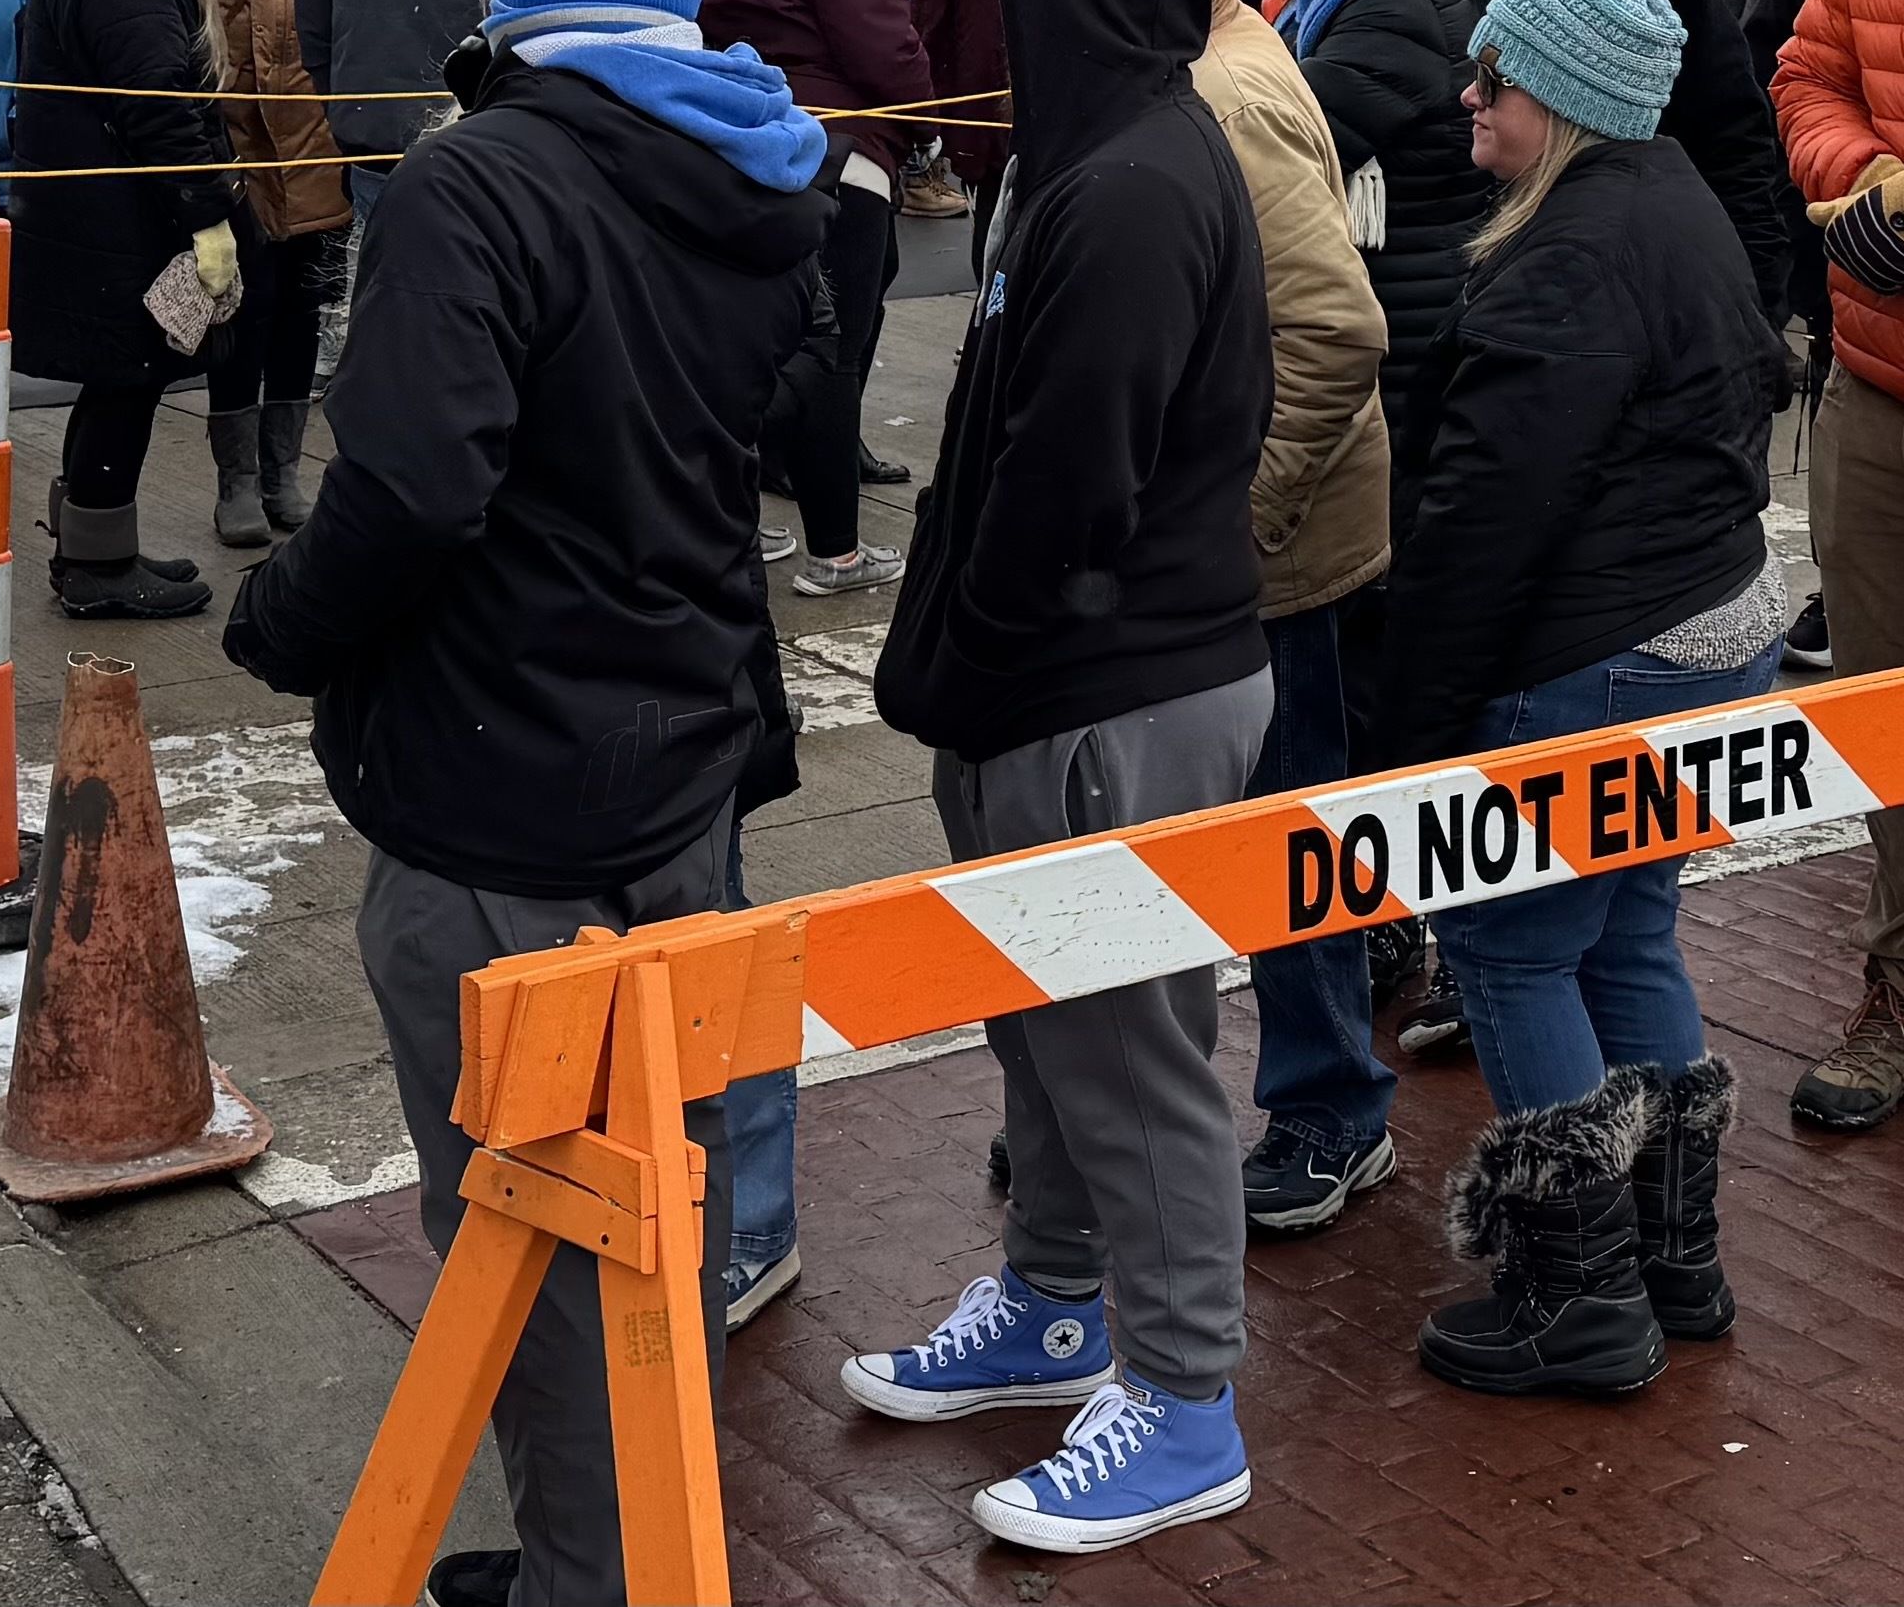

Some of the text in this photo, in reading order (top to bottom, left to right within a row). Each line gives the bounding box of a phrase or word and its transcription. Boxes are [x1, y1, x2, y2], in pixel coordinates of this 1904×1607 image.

[1287, 718, 1813, 933] DO NOT ENTER
